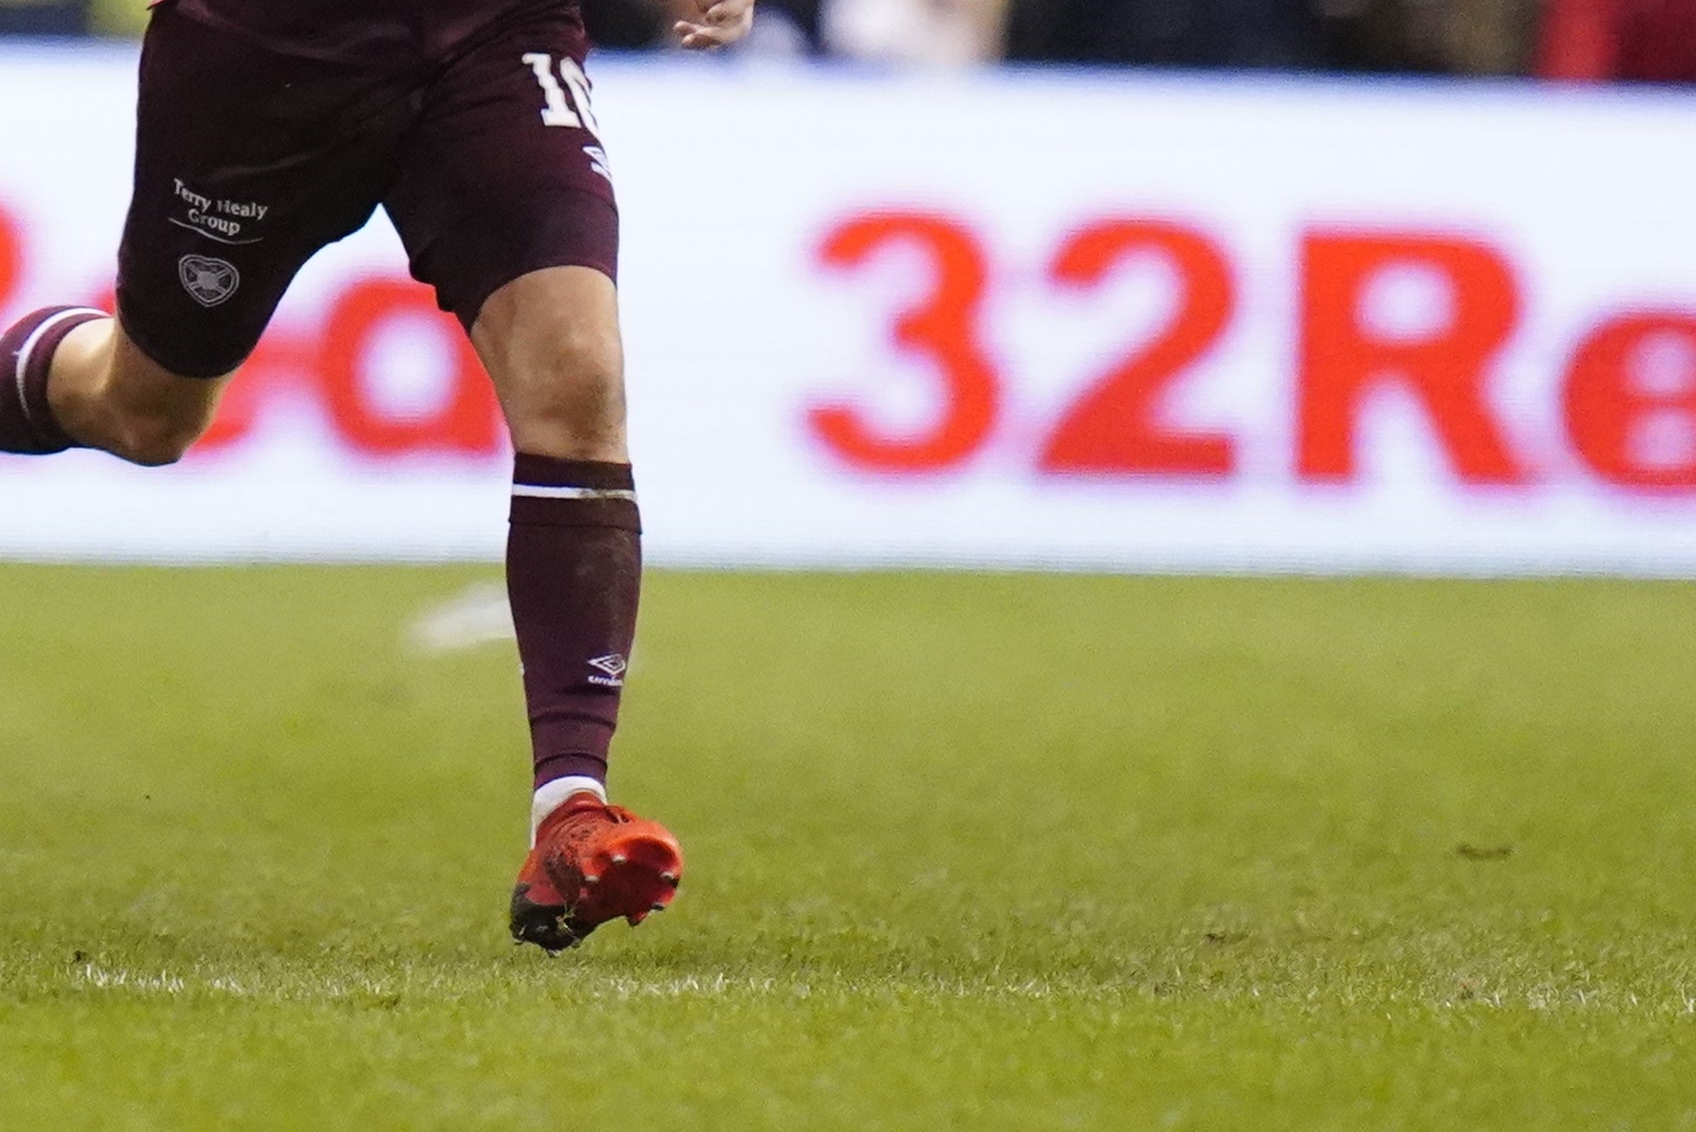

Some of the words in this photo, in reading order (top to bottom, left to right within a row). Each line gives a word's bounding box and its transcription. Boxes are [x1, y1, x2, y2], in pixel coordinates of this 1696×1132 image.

[173, 177, 212, 213] Terry
[216, 199, 269, 221] Healy
[188, 208, 241, 236] Group
